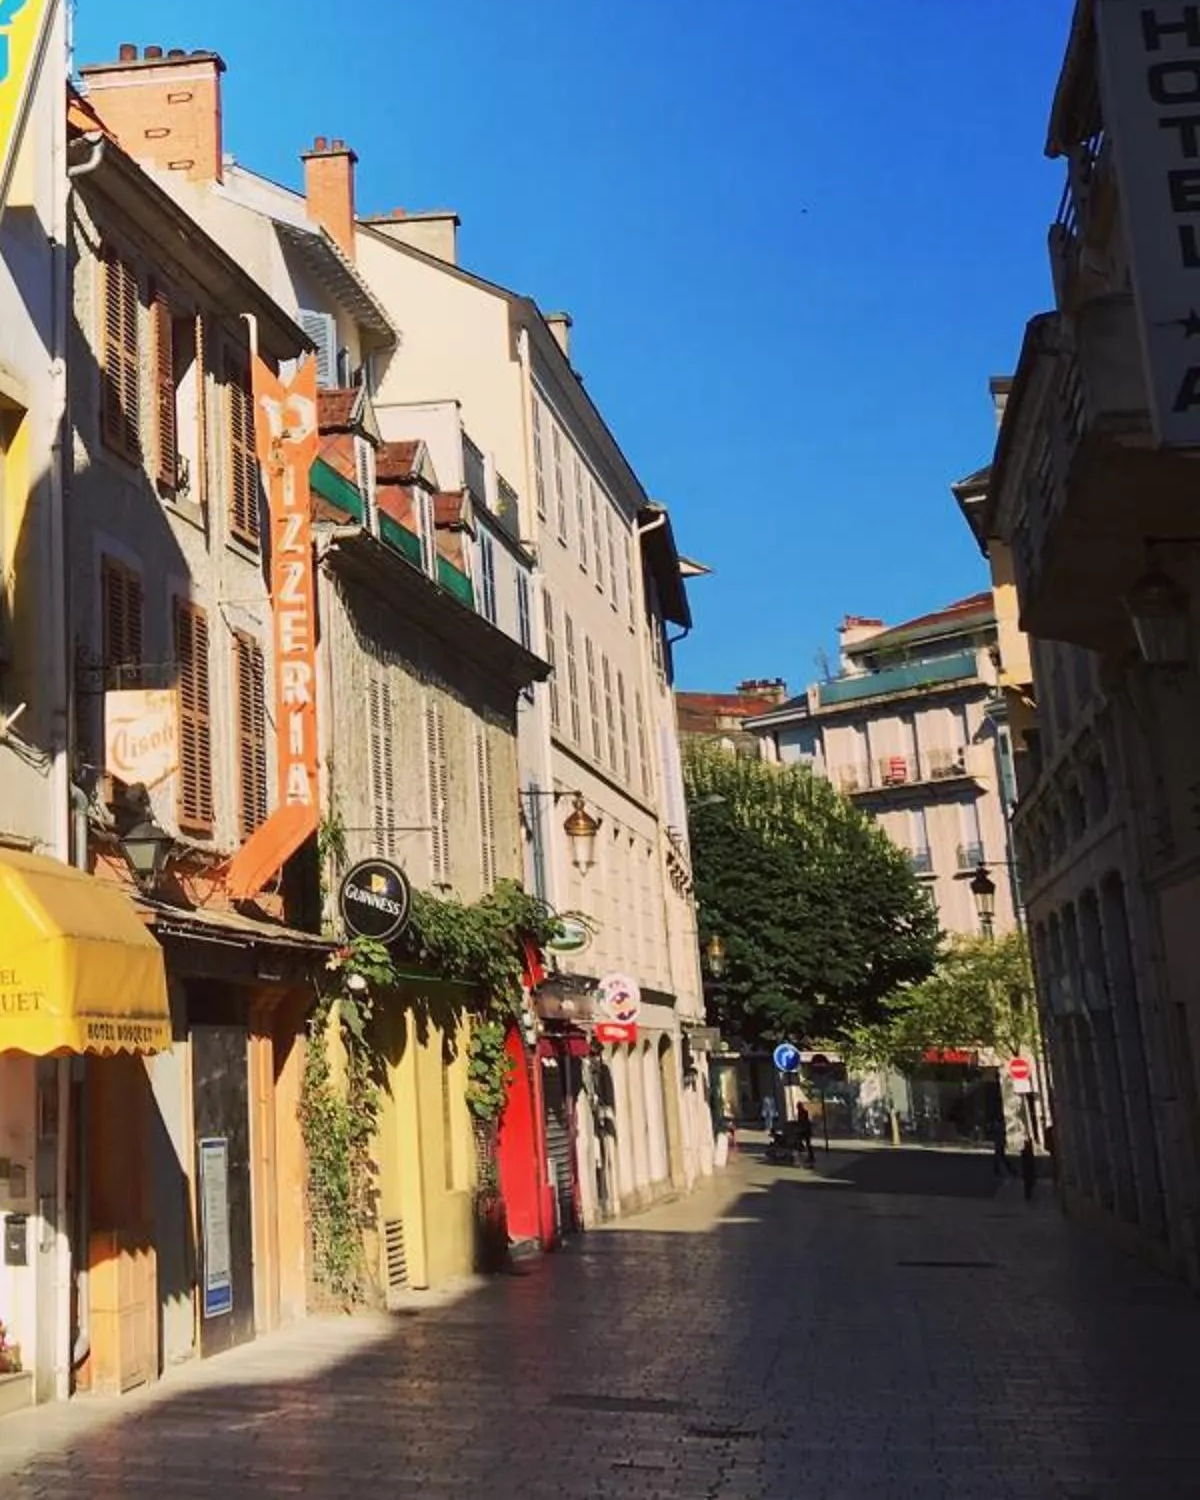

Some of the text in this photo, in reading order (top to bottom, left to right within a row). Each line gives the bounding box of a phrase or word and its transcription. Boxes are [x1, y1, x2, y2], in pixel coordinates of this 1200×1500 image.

[261, 393, 315, 806] PIZZERIA
[345, 883, 401, 916] GUINNESS
[87, 1022, 114, 1041] HOTEL
